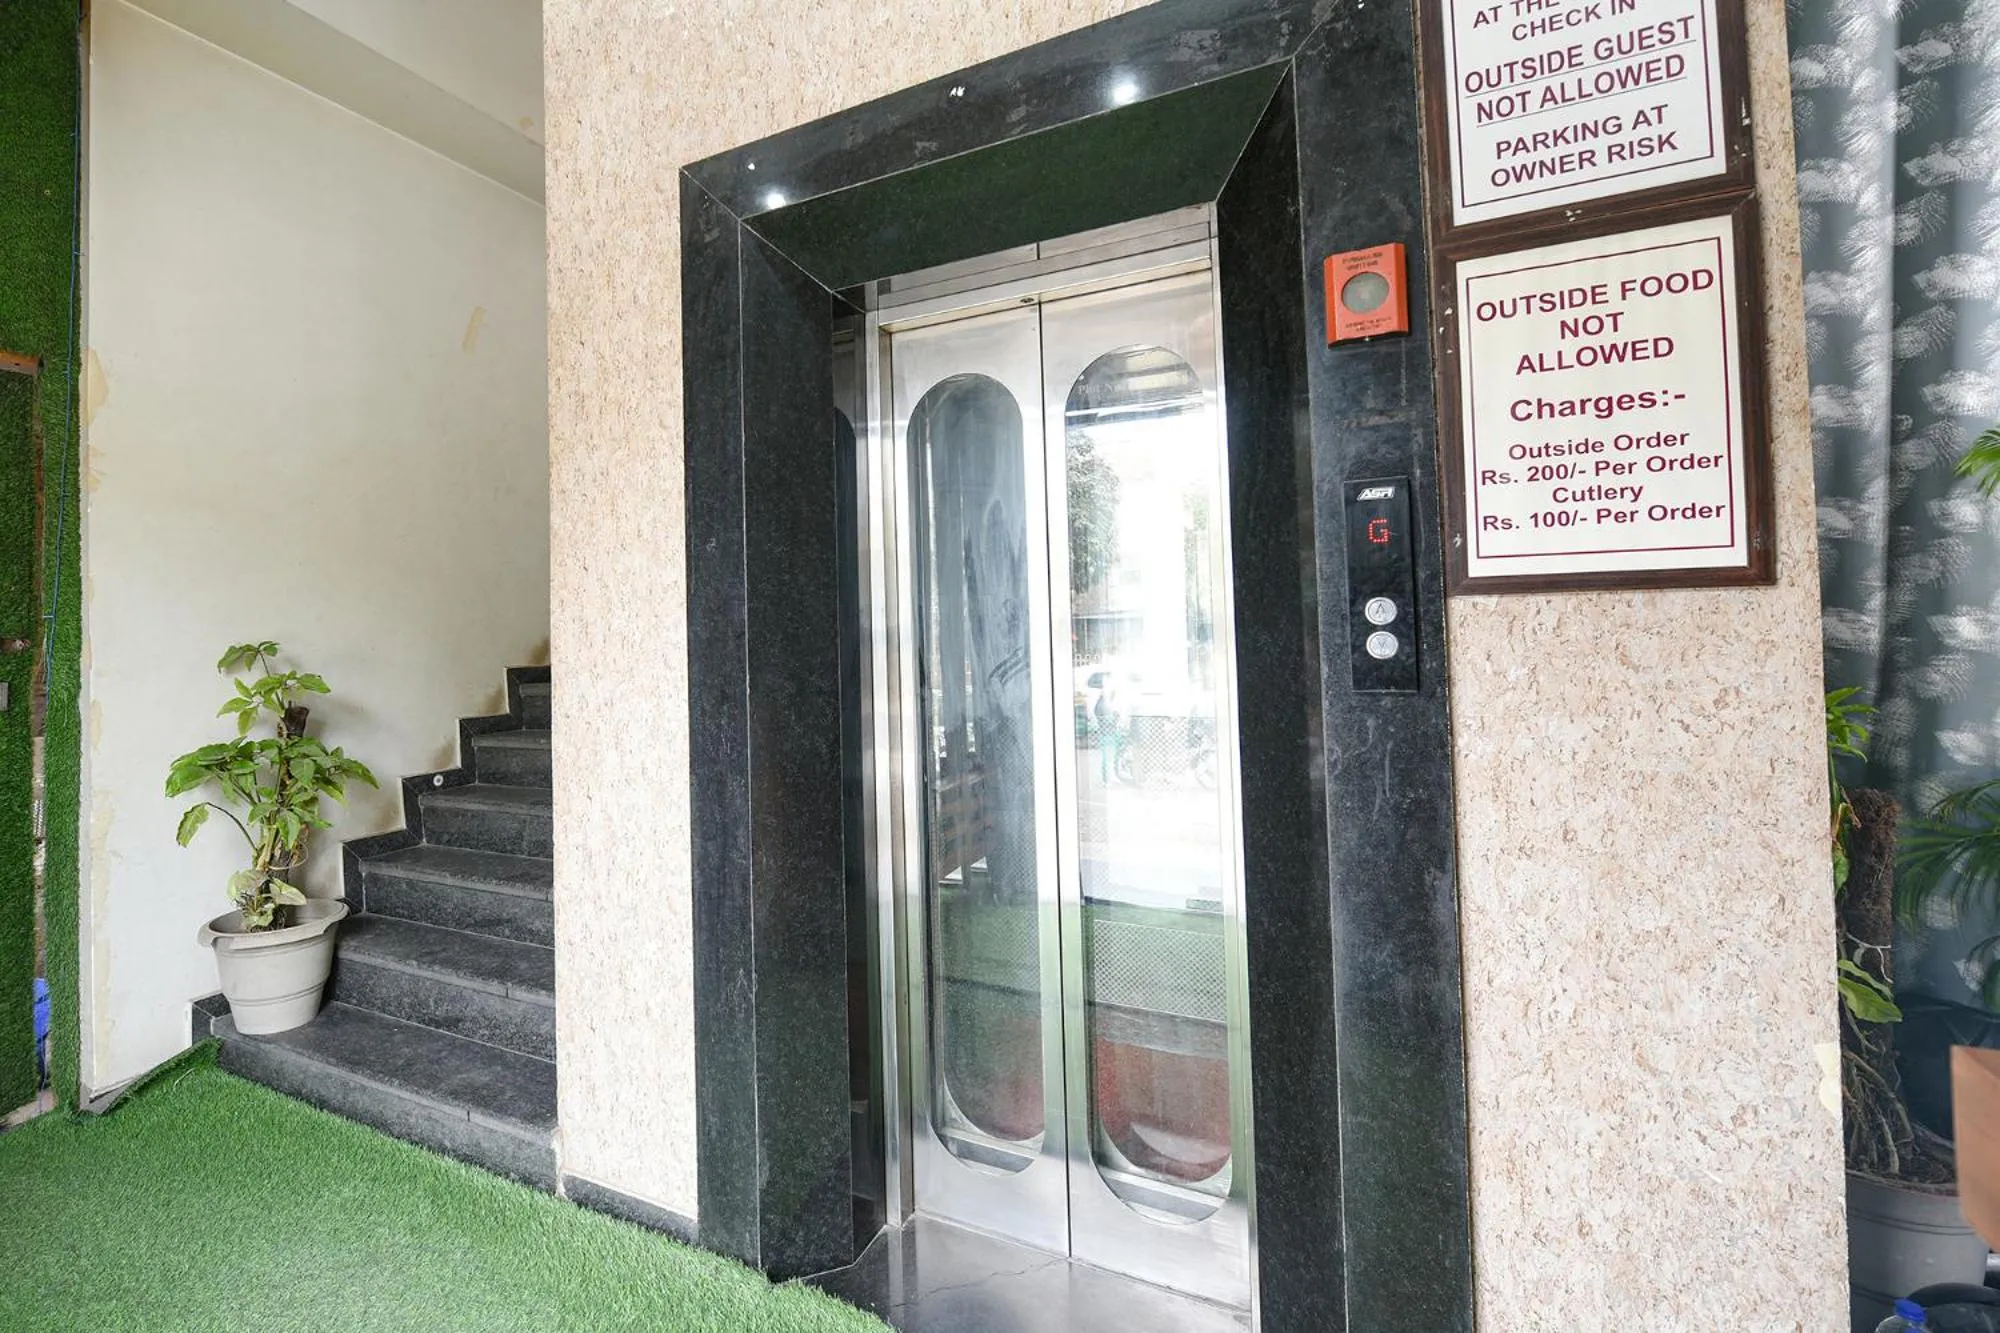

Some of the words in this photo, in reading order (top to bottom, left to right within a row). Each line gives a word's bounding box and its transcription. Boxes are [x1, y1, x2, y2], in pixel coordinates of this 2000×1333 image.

[1473, 5, 1503, 29] AT
[1511, 3, 1602, 41] CHECK
[1611, 0, 1636, 16] IN
[1464, 44, 1584, 94] OUTSIDE
[1593, 15, 1696, 61] GUEST
[1476, 90, 1532, 124] NOT
[1539, 54, 1685, 109] ALLOWED
[1495, 115, 1623, 160] PARKING
[1631, 103, 1669, 131] AT
[1490, 149, 1597, 188] OWNER
[1607, 130, 1678, 164] RISK
[1476, 283, 1609, 322] OUTSIDE
[1620, 268, 1714, 302] FOOD
[1559, 311, 1625, 340] NOT
[1515, 336, 1674, 376] ALLOWED
[1510, 388, 1686, 422] Charges:-
[1508, 437, 1605, 461] Outside
[1613, 431, 1690, 452] Order
[1481, 469, 1519, 486] Rs.
[1527, 461, 1587, 483] 200/-
[1594, 460, 1638, 477] Per
[1646, 452, 1724, 473] Order
[1552, 484, 1644, 504] Cutlery
[1368, 519, 1391, 543] G
[1483, 515, 1520, 531] Rs.
[1529, 508, 1588, 529] 100/-
[1596, 507, 1640, 526] Per
[1647, 502, 1725, 522] Order
